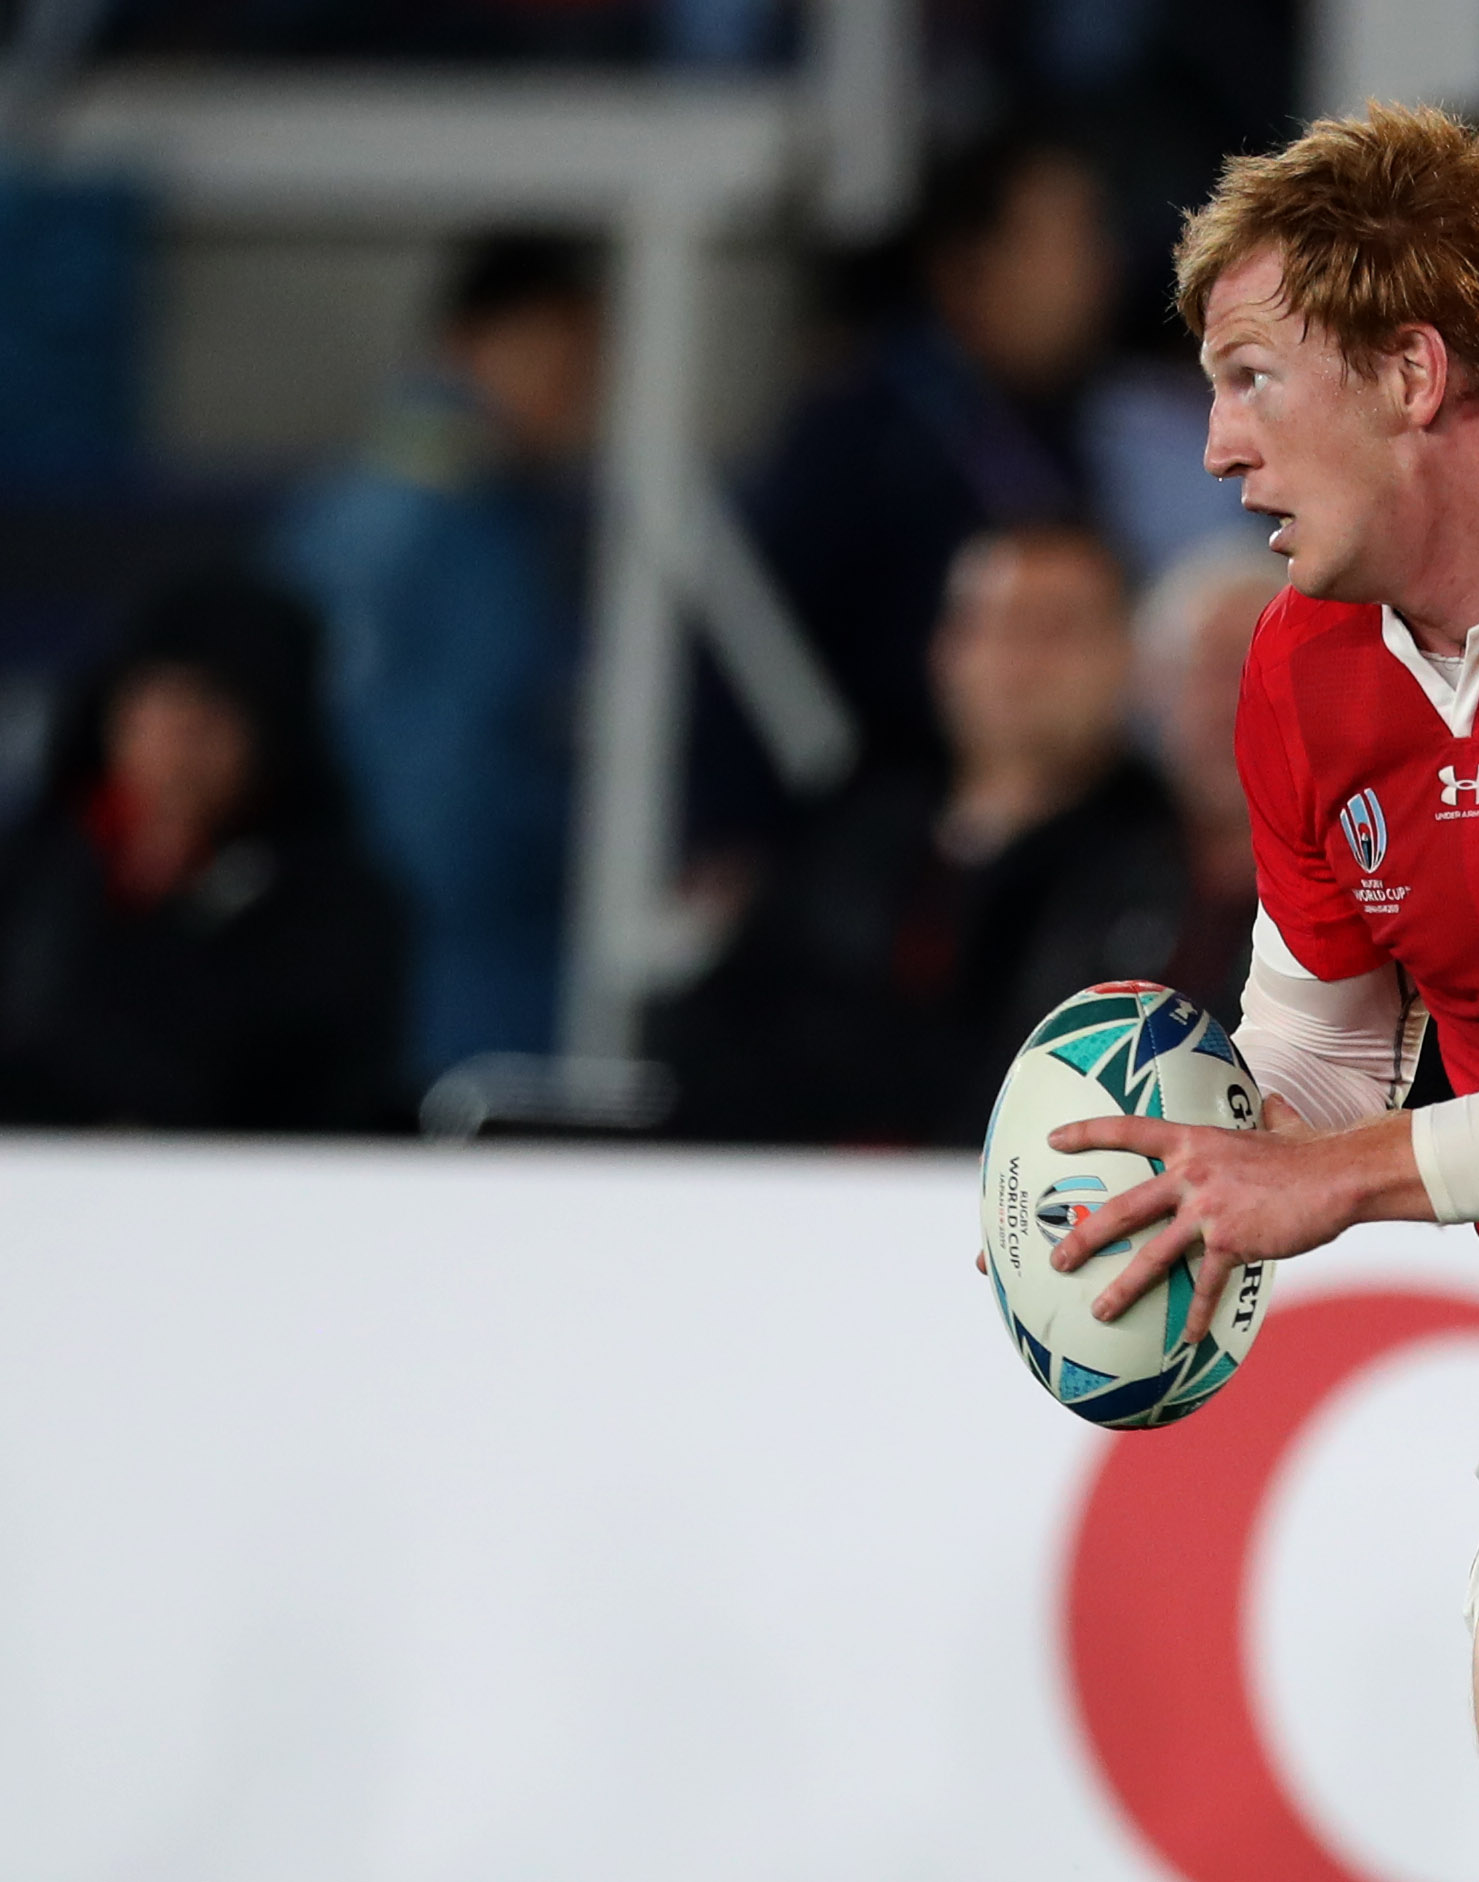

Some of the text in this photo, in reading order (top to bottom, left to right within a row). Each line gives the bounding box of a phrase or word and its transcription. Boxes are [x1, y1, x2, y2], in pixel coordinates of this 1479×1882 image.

[1435, 810, 1461, 820] UNDER
[1008, 1156, 1020, 1228] WORLD
[1020, 1190, 1029, 1236] RUGBY
